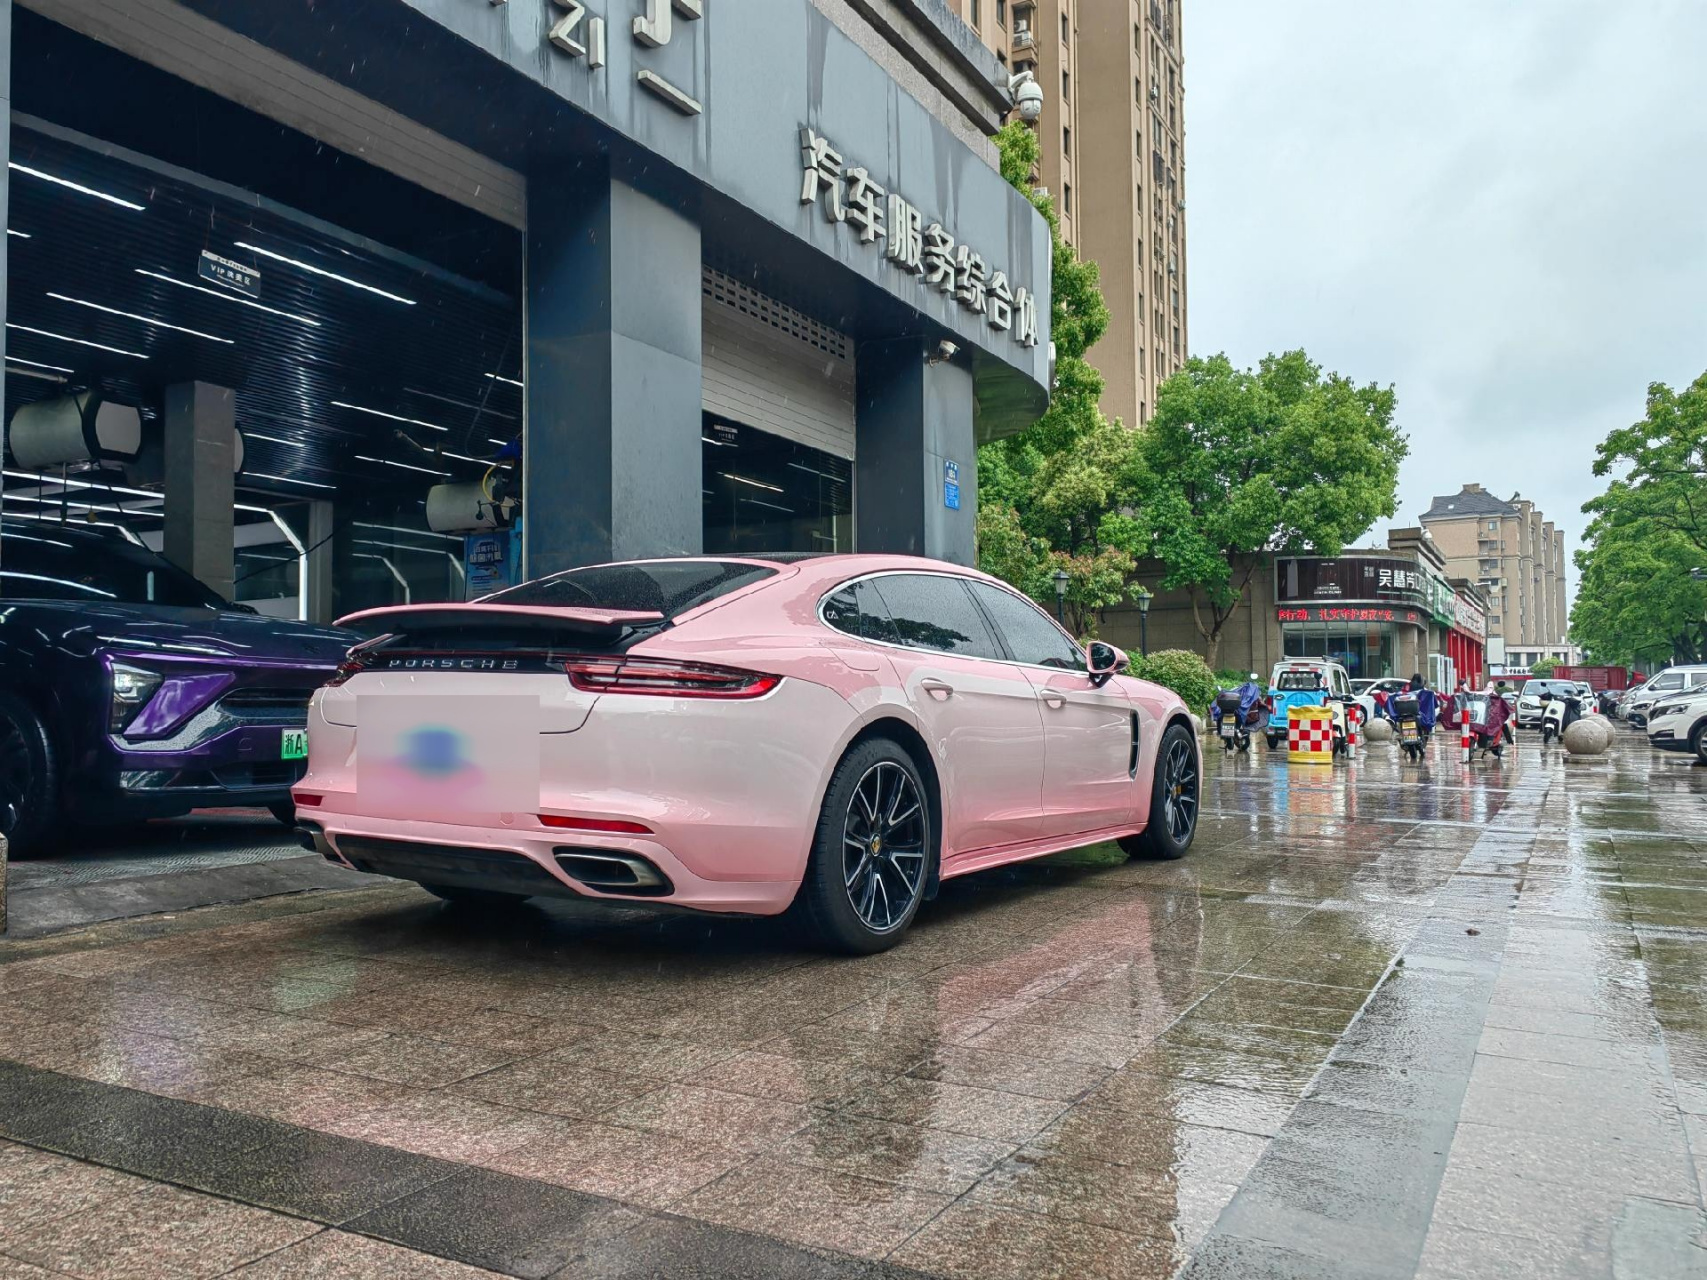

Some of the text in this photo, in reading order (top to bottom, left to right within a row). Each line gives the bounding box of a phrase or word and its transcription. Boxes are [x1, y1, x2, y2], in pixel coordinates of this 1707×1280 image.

[801, 127, 1039, 347] 汽车服务综合体
[389, 659, 518, 669] PORSCHE
